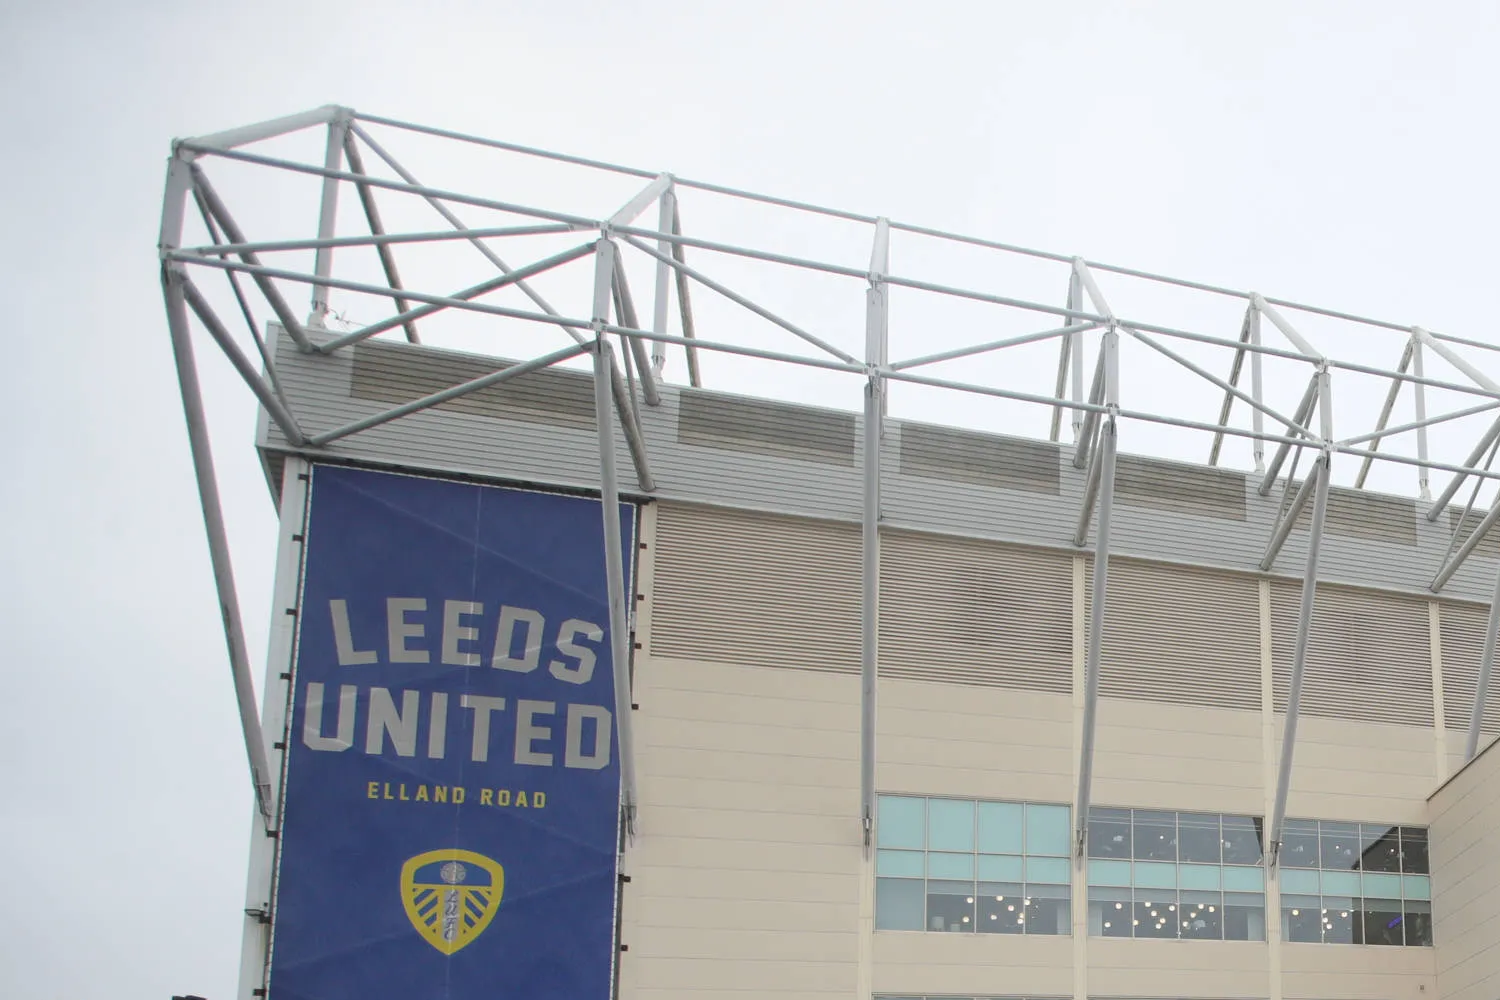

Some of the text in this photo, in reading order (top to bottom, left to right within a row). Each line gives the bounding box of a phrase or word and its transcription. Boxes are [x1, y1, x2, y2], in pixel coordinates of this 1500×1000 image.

[329, 597, 604, 685] LEEDS
[302, 682, 613, 770] UNITED
[367, 781, 547, 809] ELLAND ROAD
